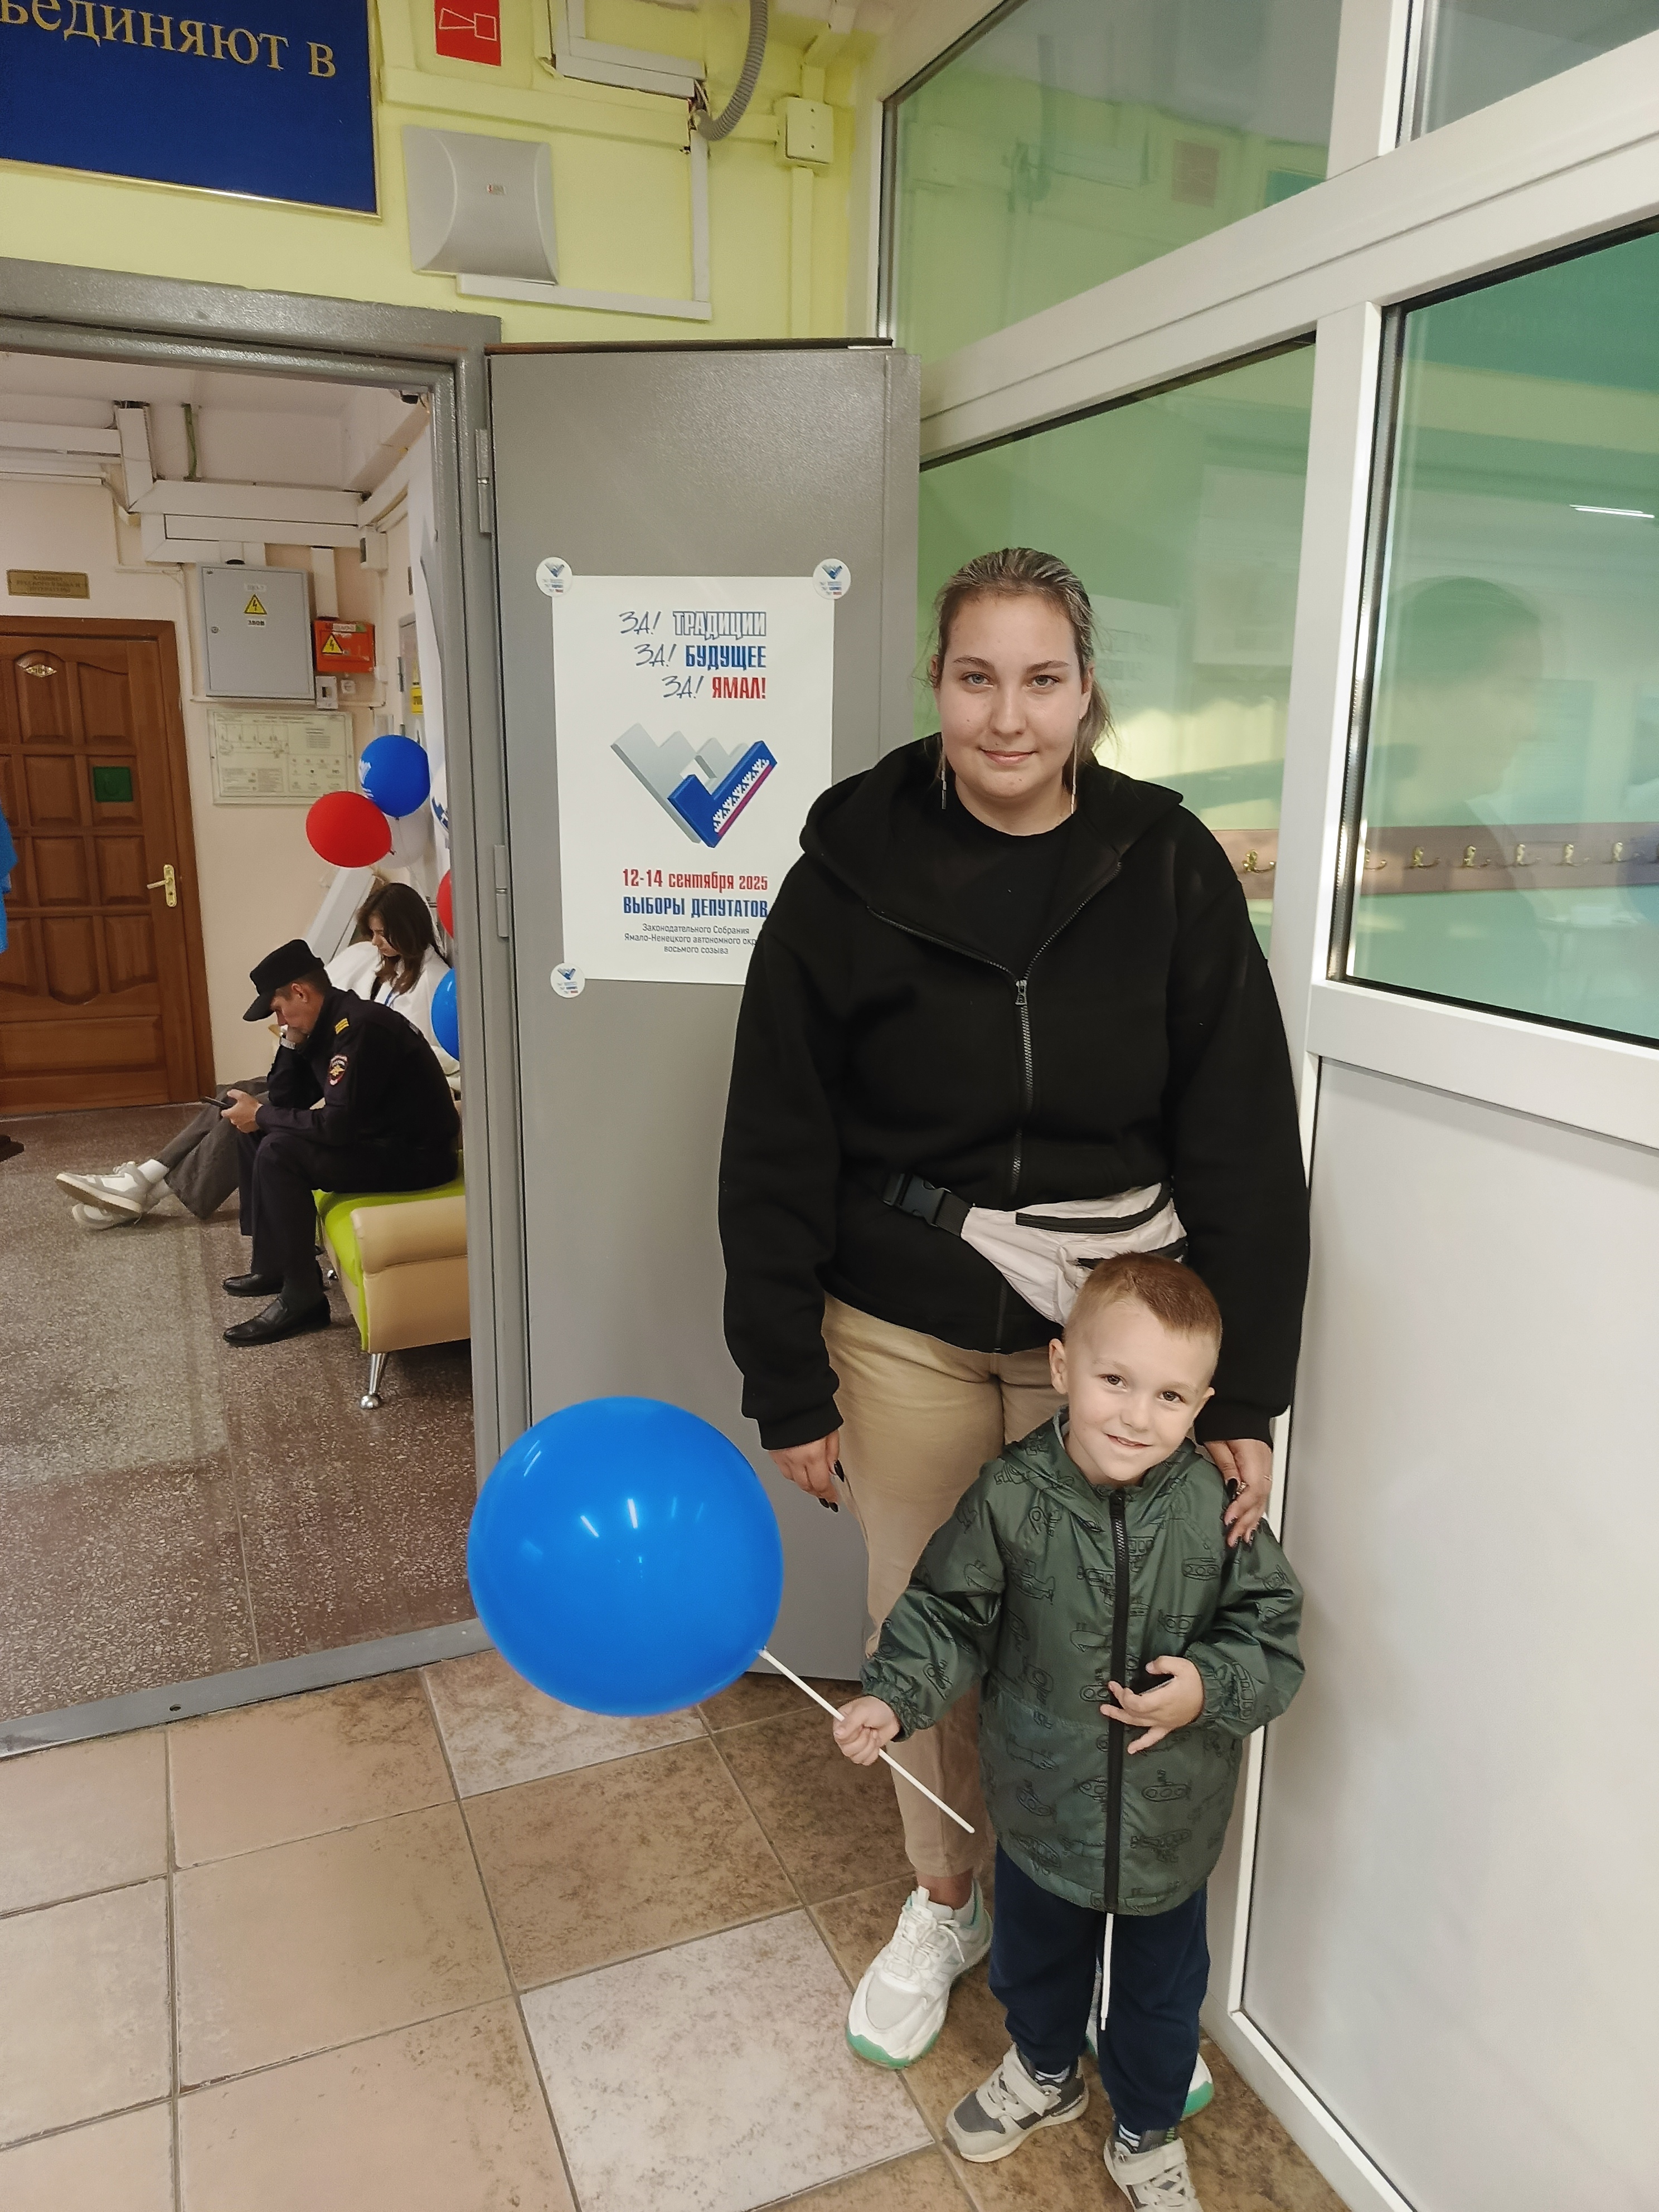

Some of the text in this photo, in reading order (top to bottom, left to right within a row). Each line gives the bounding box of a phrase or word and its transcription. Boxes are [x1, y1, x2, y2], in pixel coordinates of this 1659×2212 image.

[307, 41, 336, 77] в
[618, 611, 767, 640] ЗА! ТРАДИЦИИ
[634, 644, 766, 671] ЗА! БУДУЩЕЕ
[662, 676, 766, 699] ЗА! ЯМАЛ!
[623, 869, 768, 893] 12-14 сентября 2025
[623, 896, 768, 918] ВЫБОРЫ ДЕПУТАТОВ
[624, 933, 757, 948] Ямало-Ненецкого автономного окр
[642, 923, 750, 936] Законодательного Собрания
[664, 945, 699, 954] восьмого
